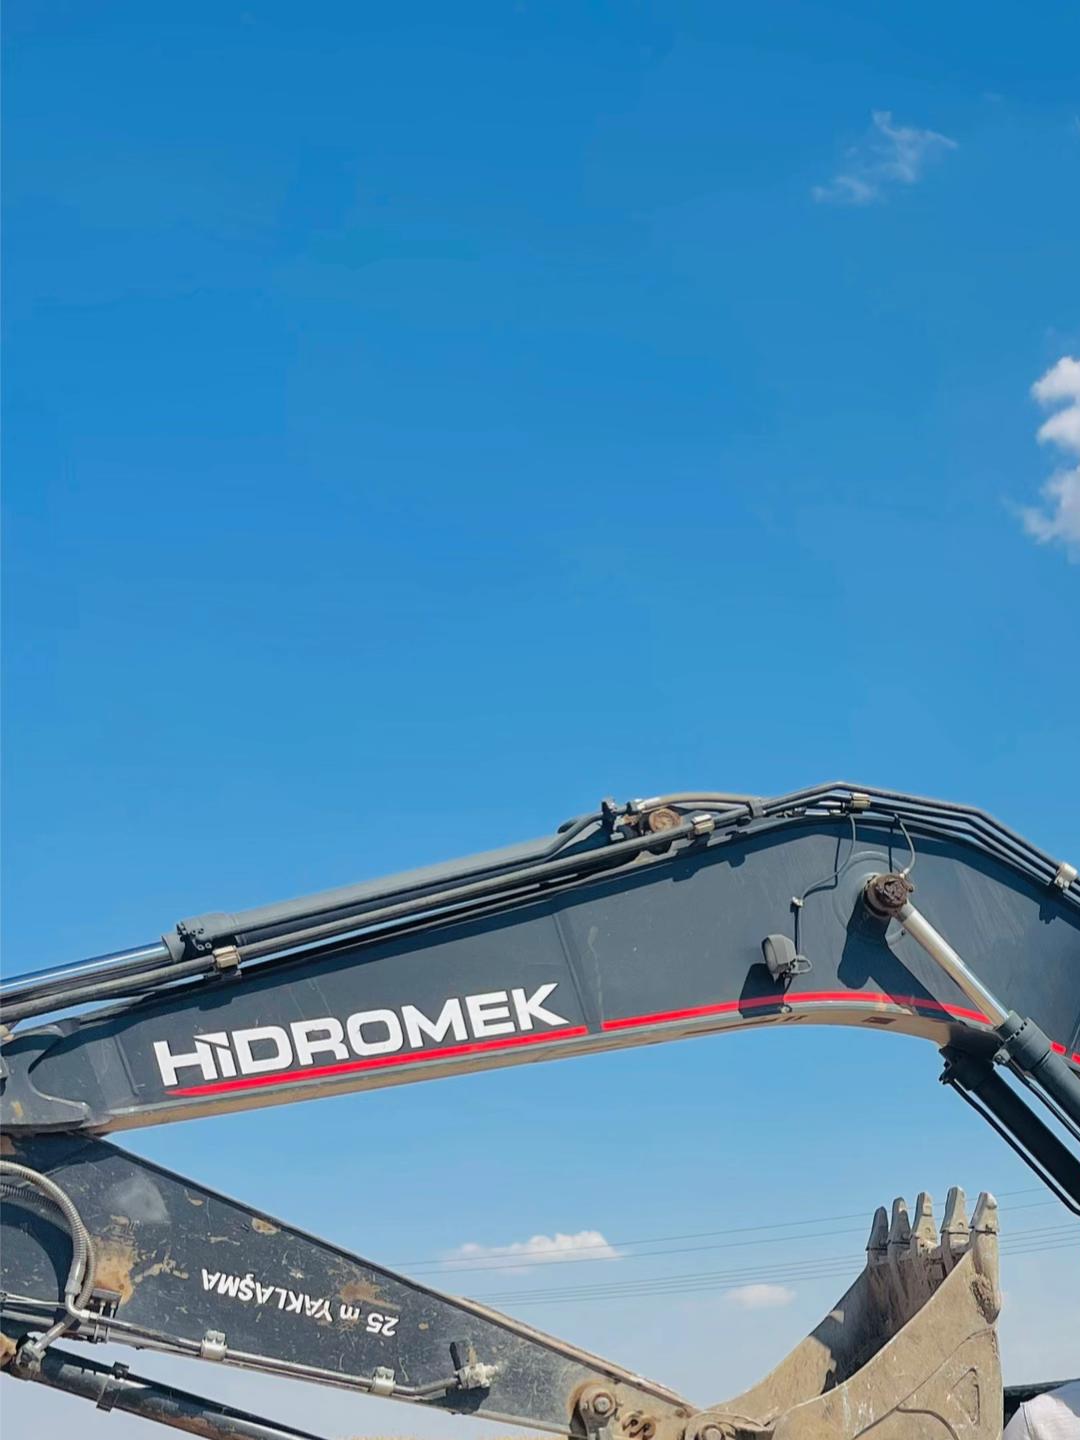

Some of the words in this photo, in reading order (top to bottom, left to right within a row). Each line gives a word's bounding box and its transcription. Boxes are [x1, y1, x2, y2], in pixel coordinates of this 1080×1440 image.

[201, 1268, 333, 1322] YAKLAŞMA
[339, 1304, 360, 1322] m
[366, 1312, 400, 1337] 25
